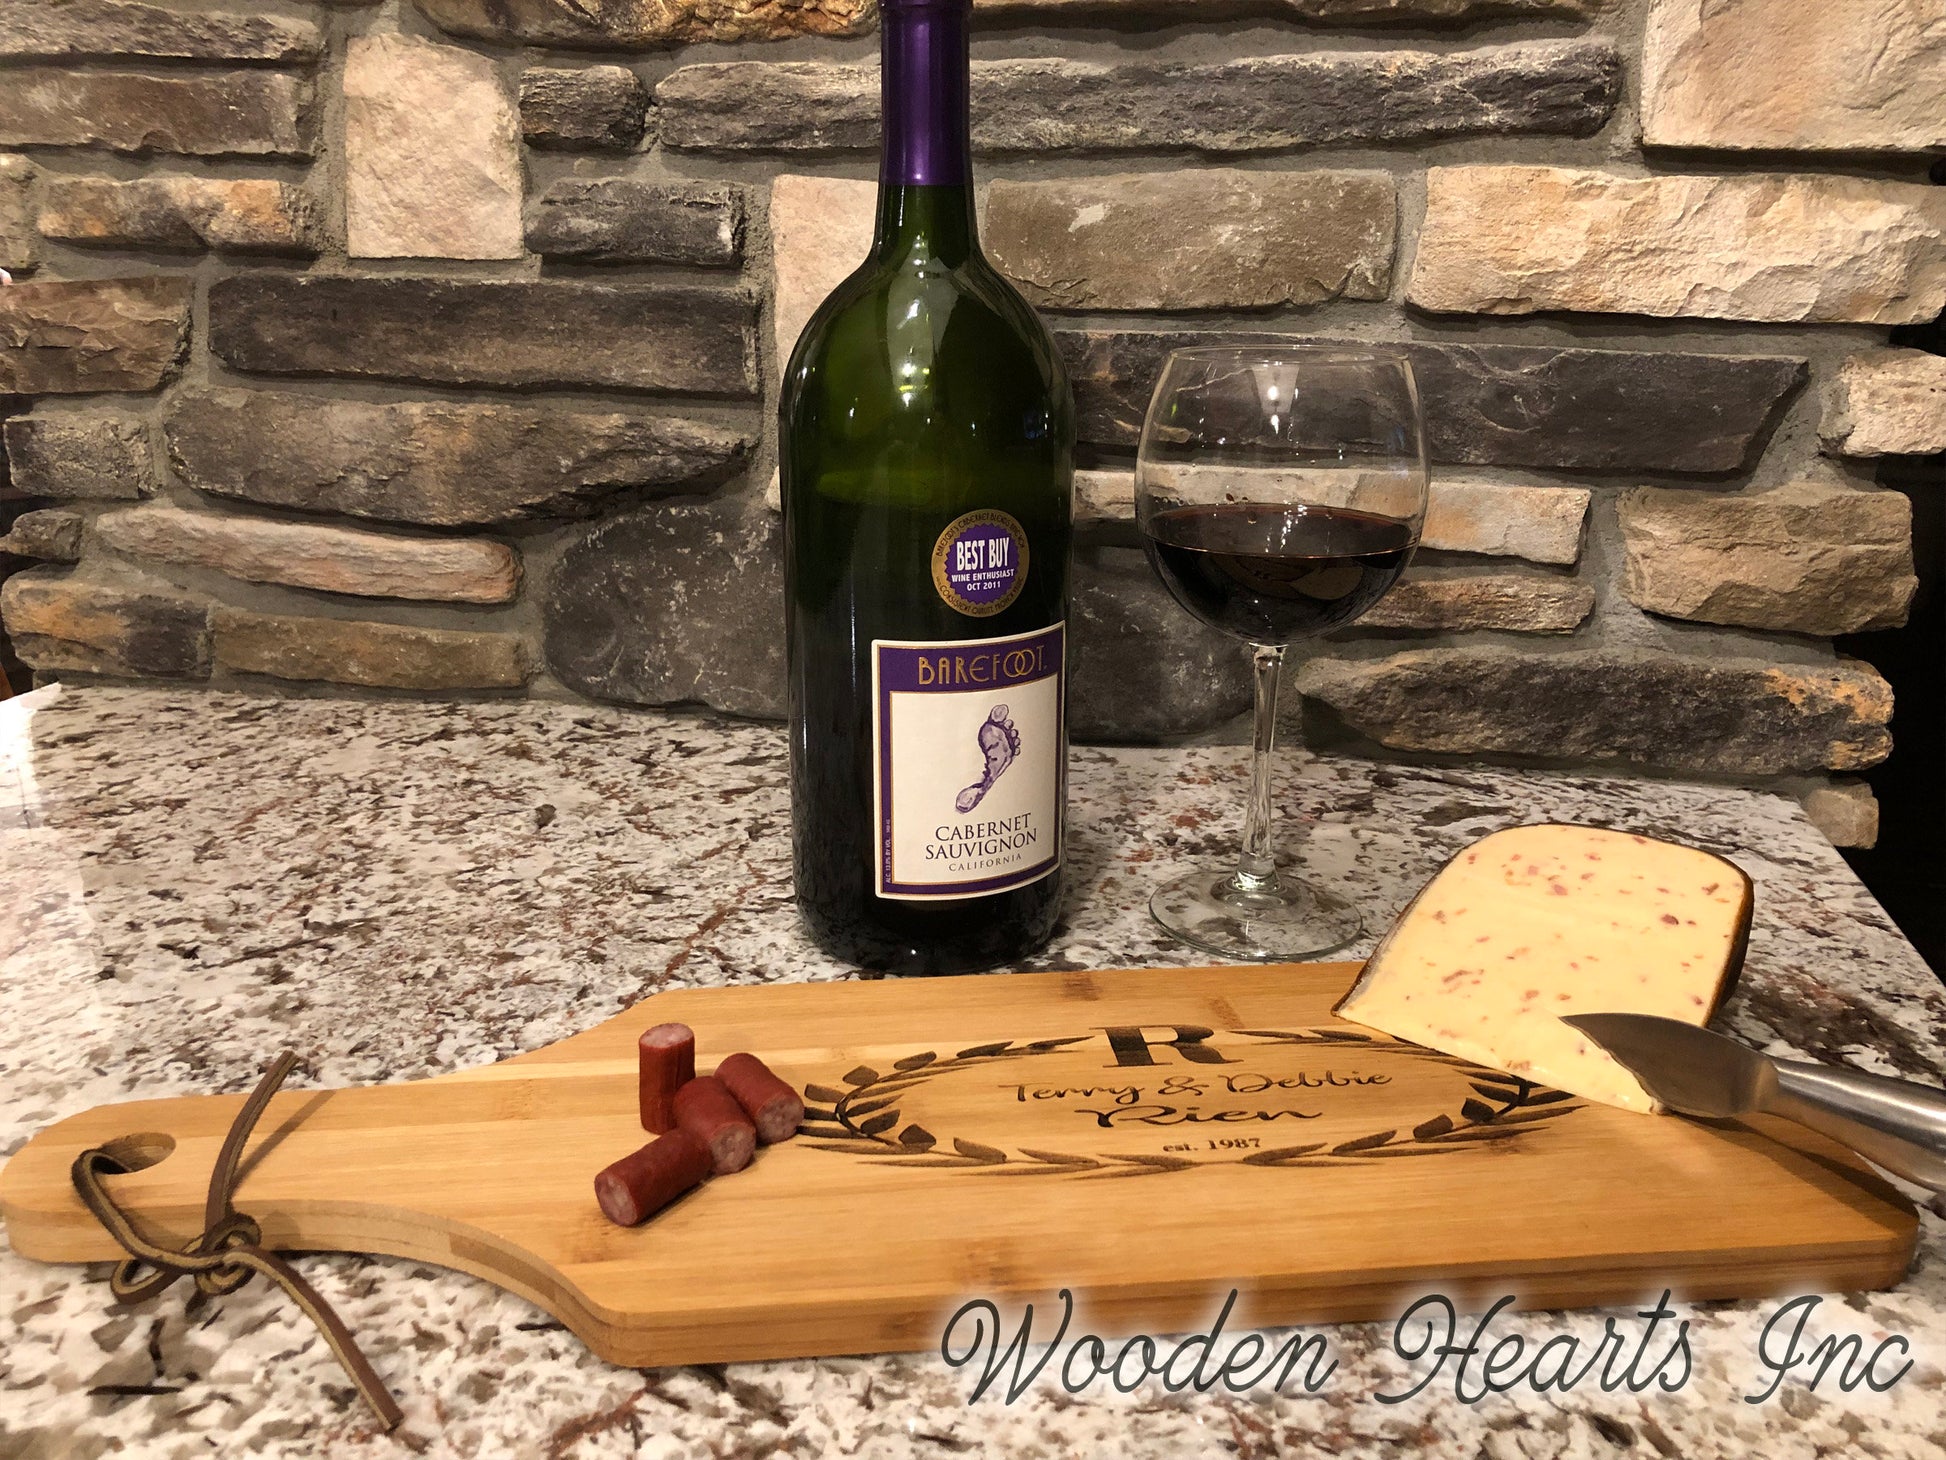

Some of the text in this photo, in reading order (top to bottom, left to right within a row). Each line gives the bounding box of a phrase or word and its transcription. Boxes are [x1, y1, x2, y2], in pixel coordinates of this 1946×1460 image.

[956, 537, 1010, 571] BEST BUY
[951, 573, 970, 583] WINE
[973, 569, 1015, 581] ENTHUSIAST
[967, 581, 1001, 591] OCT 2011
[919, 645, 1045, 685] BAREFOOT
[935, 812, 1031, 842] CABERNET
[925, 828, 1037, 860] SAUVIGNON
[948, 853, 1022, 872] CALIFORNIA
[1089, 1024, 1244, 1068] R
[998, 1070, 1393, 1105] Terry & Debbie
[1074, 1104, 1324, 1129] Rien
[1162, 1137, 1261, 1153] est. 1987
